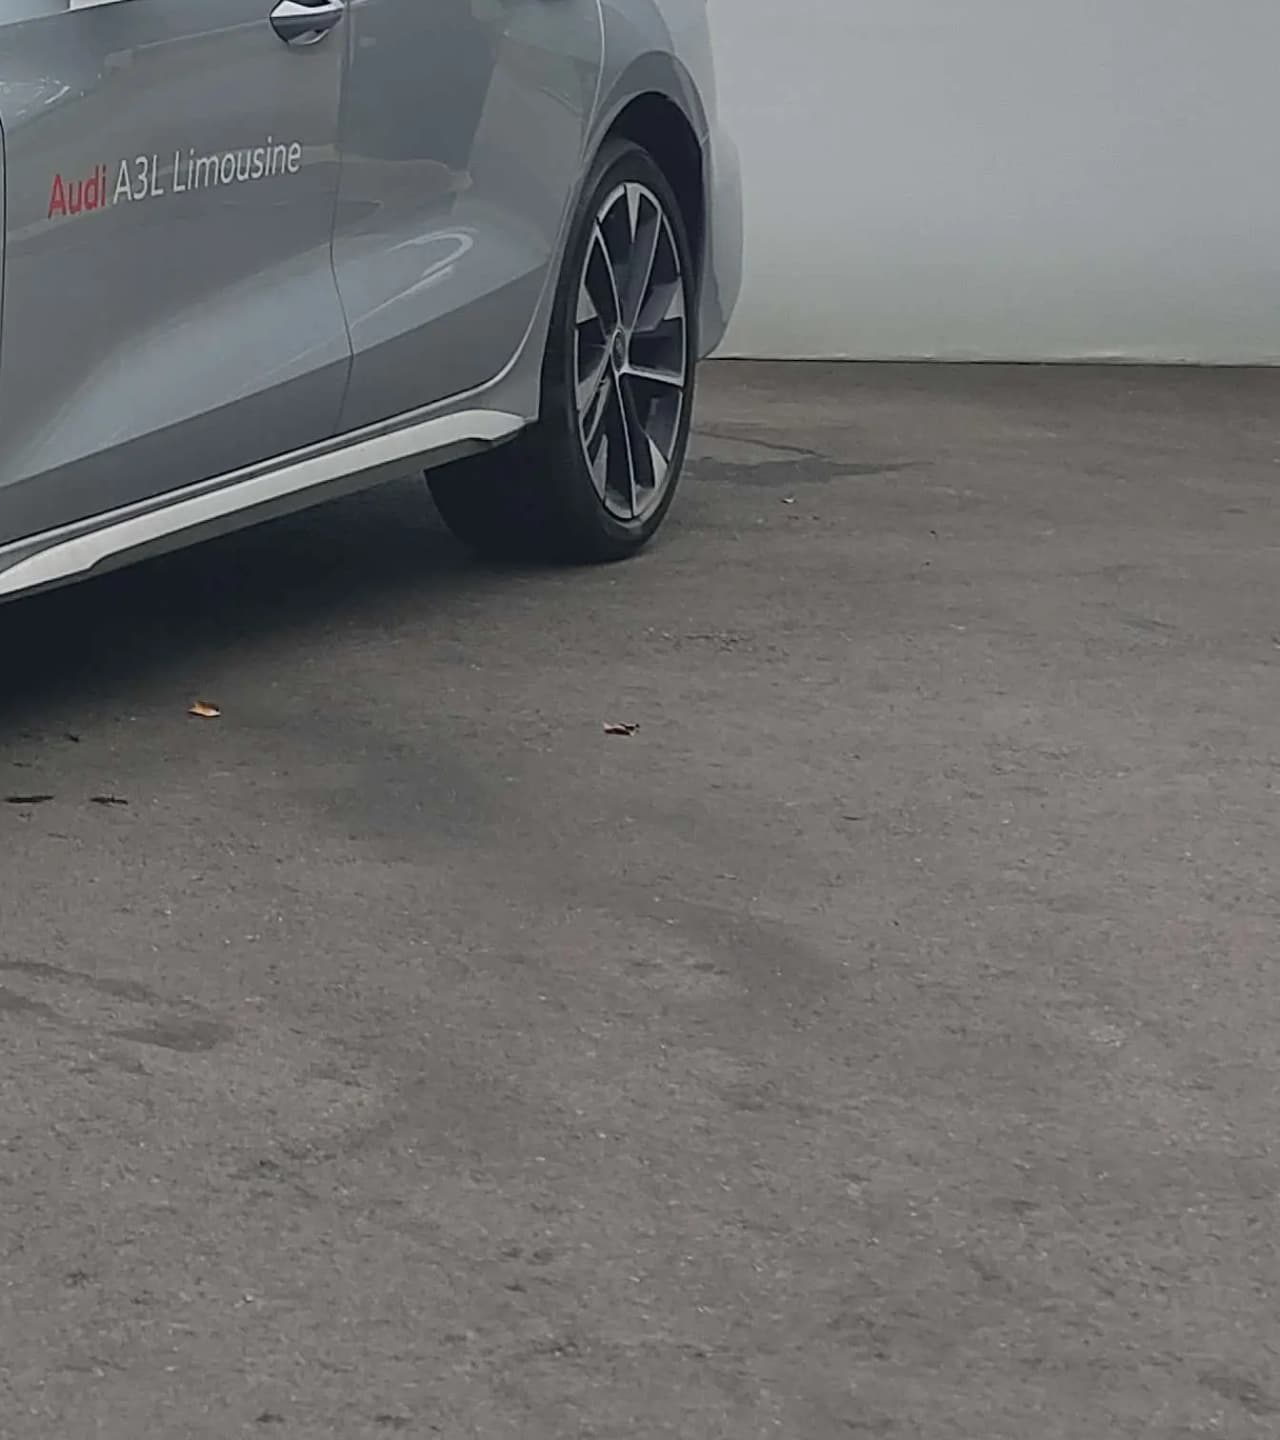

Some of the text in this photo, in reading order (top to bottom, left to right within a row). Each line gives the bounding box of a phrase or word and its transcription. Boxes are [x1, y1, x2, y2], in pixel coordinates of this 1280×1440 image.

[48, 136, 302, 219] Audi A3L Limousine
